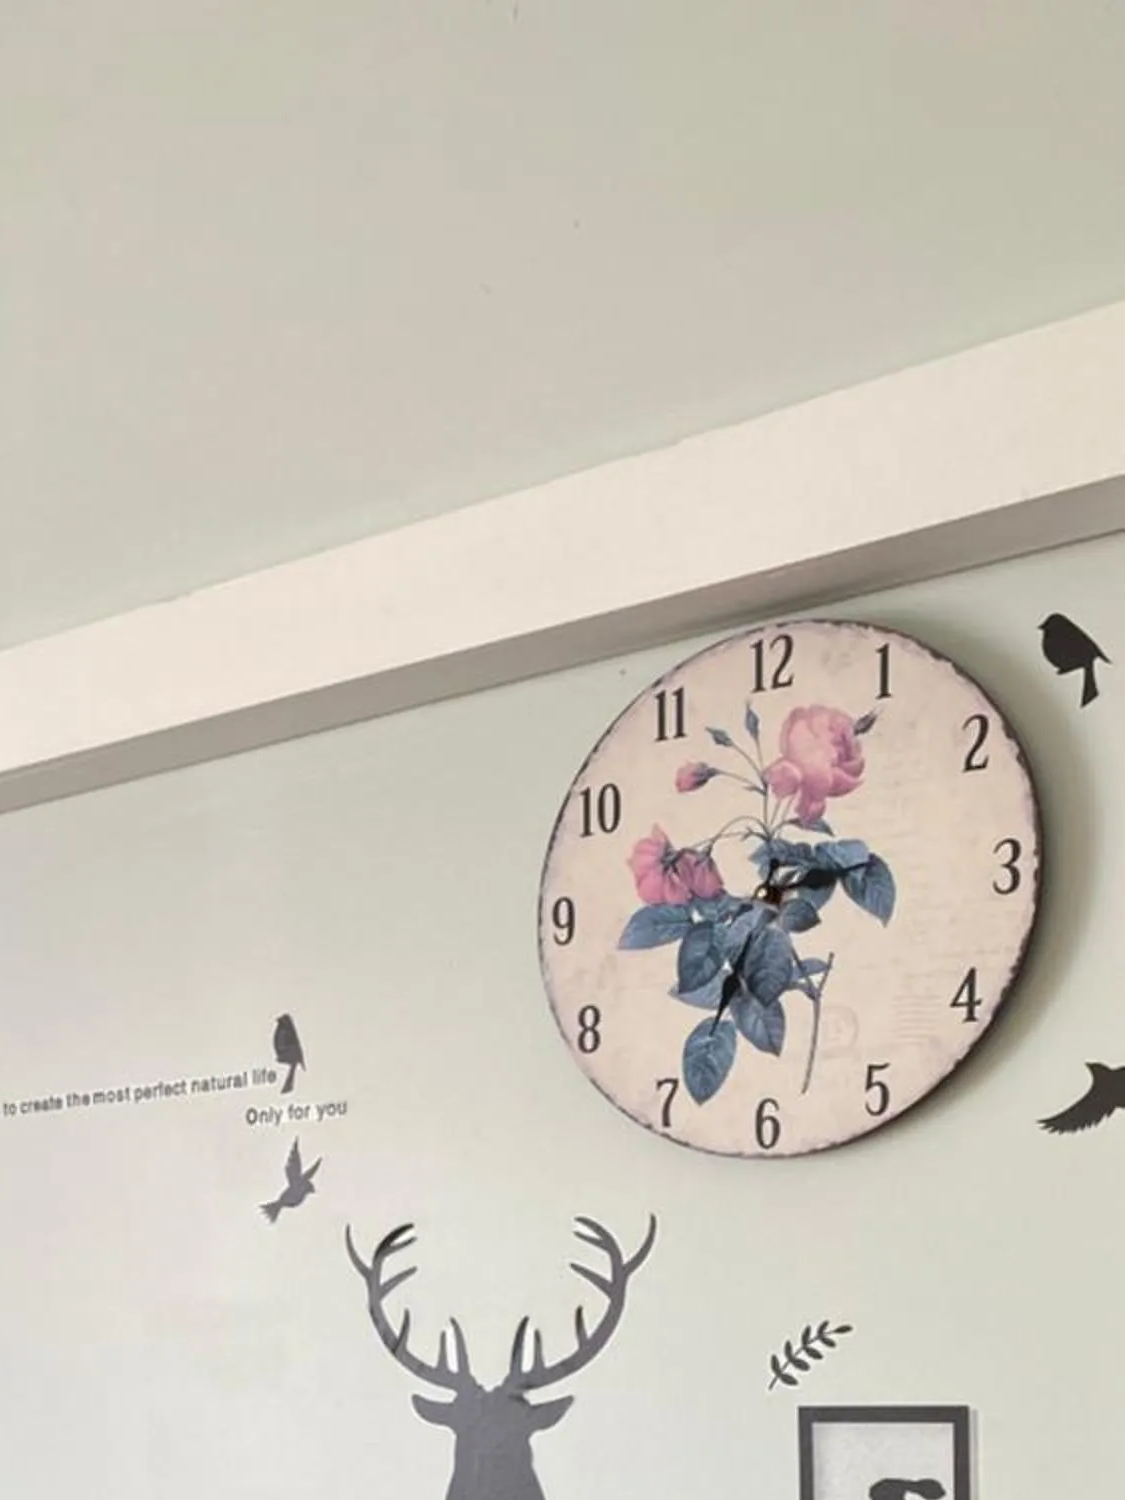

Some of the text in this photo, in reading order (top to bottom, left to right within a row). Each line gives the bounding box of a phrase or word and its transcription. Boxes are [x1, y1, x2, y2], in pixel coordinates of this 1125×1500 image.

[750, 634, 794, 694] 12
[875, 644, 893, 699] 1
[655, 687, 686, 742] 11
[962, 714, 991, 773] 2
[579, 783, 621, 837] 10
[992, 838, 1022, 895] 3
[552, 896, 575, 945] 9
[950, 967, 982, 1023] 4
[578, 1005, 601, 1054] 8
[2, 1068, 277, 1117] to create the most perfect natural life
[245, 1100, 348, 1127] Only for you
[656, 1078, 679, 1128] 7
[865, 1063, 891, 1117] 5
[755, 1098, 781, 1149] 6
